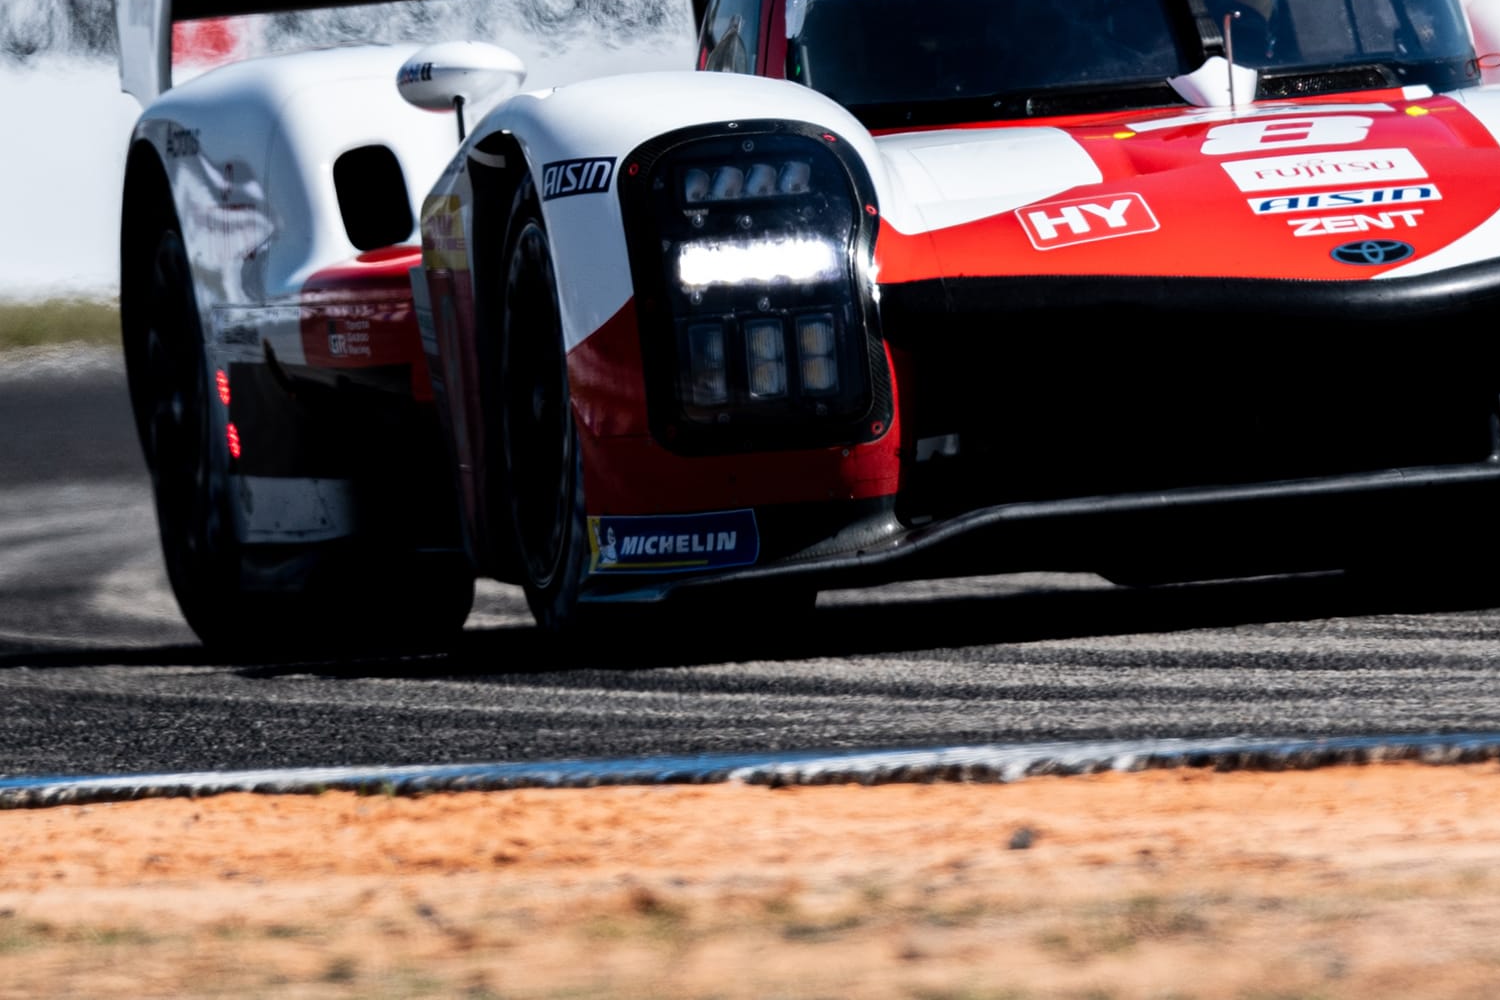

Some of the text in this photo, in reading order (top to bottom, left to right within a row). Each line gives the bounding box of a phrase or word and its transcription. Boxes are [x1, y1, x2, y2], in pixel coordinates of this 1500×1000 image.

[1200, 115, 1374, 156] 8
[543, 161, 612, 196] AISIN
[1254, 158, 1396, 179] FUJITSU
[1258, 186, 1432, 212] AISIN
[1027, 198, 1133, 241] HY
[1286, 208, 1425, 237] ZENT
[620, 530, 737, 556] MICHELIN
